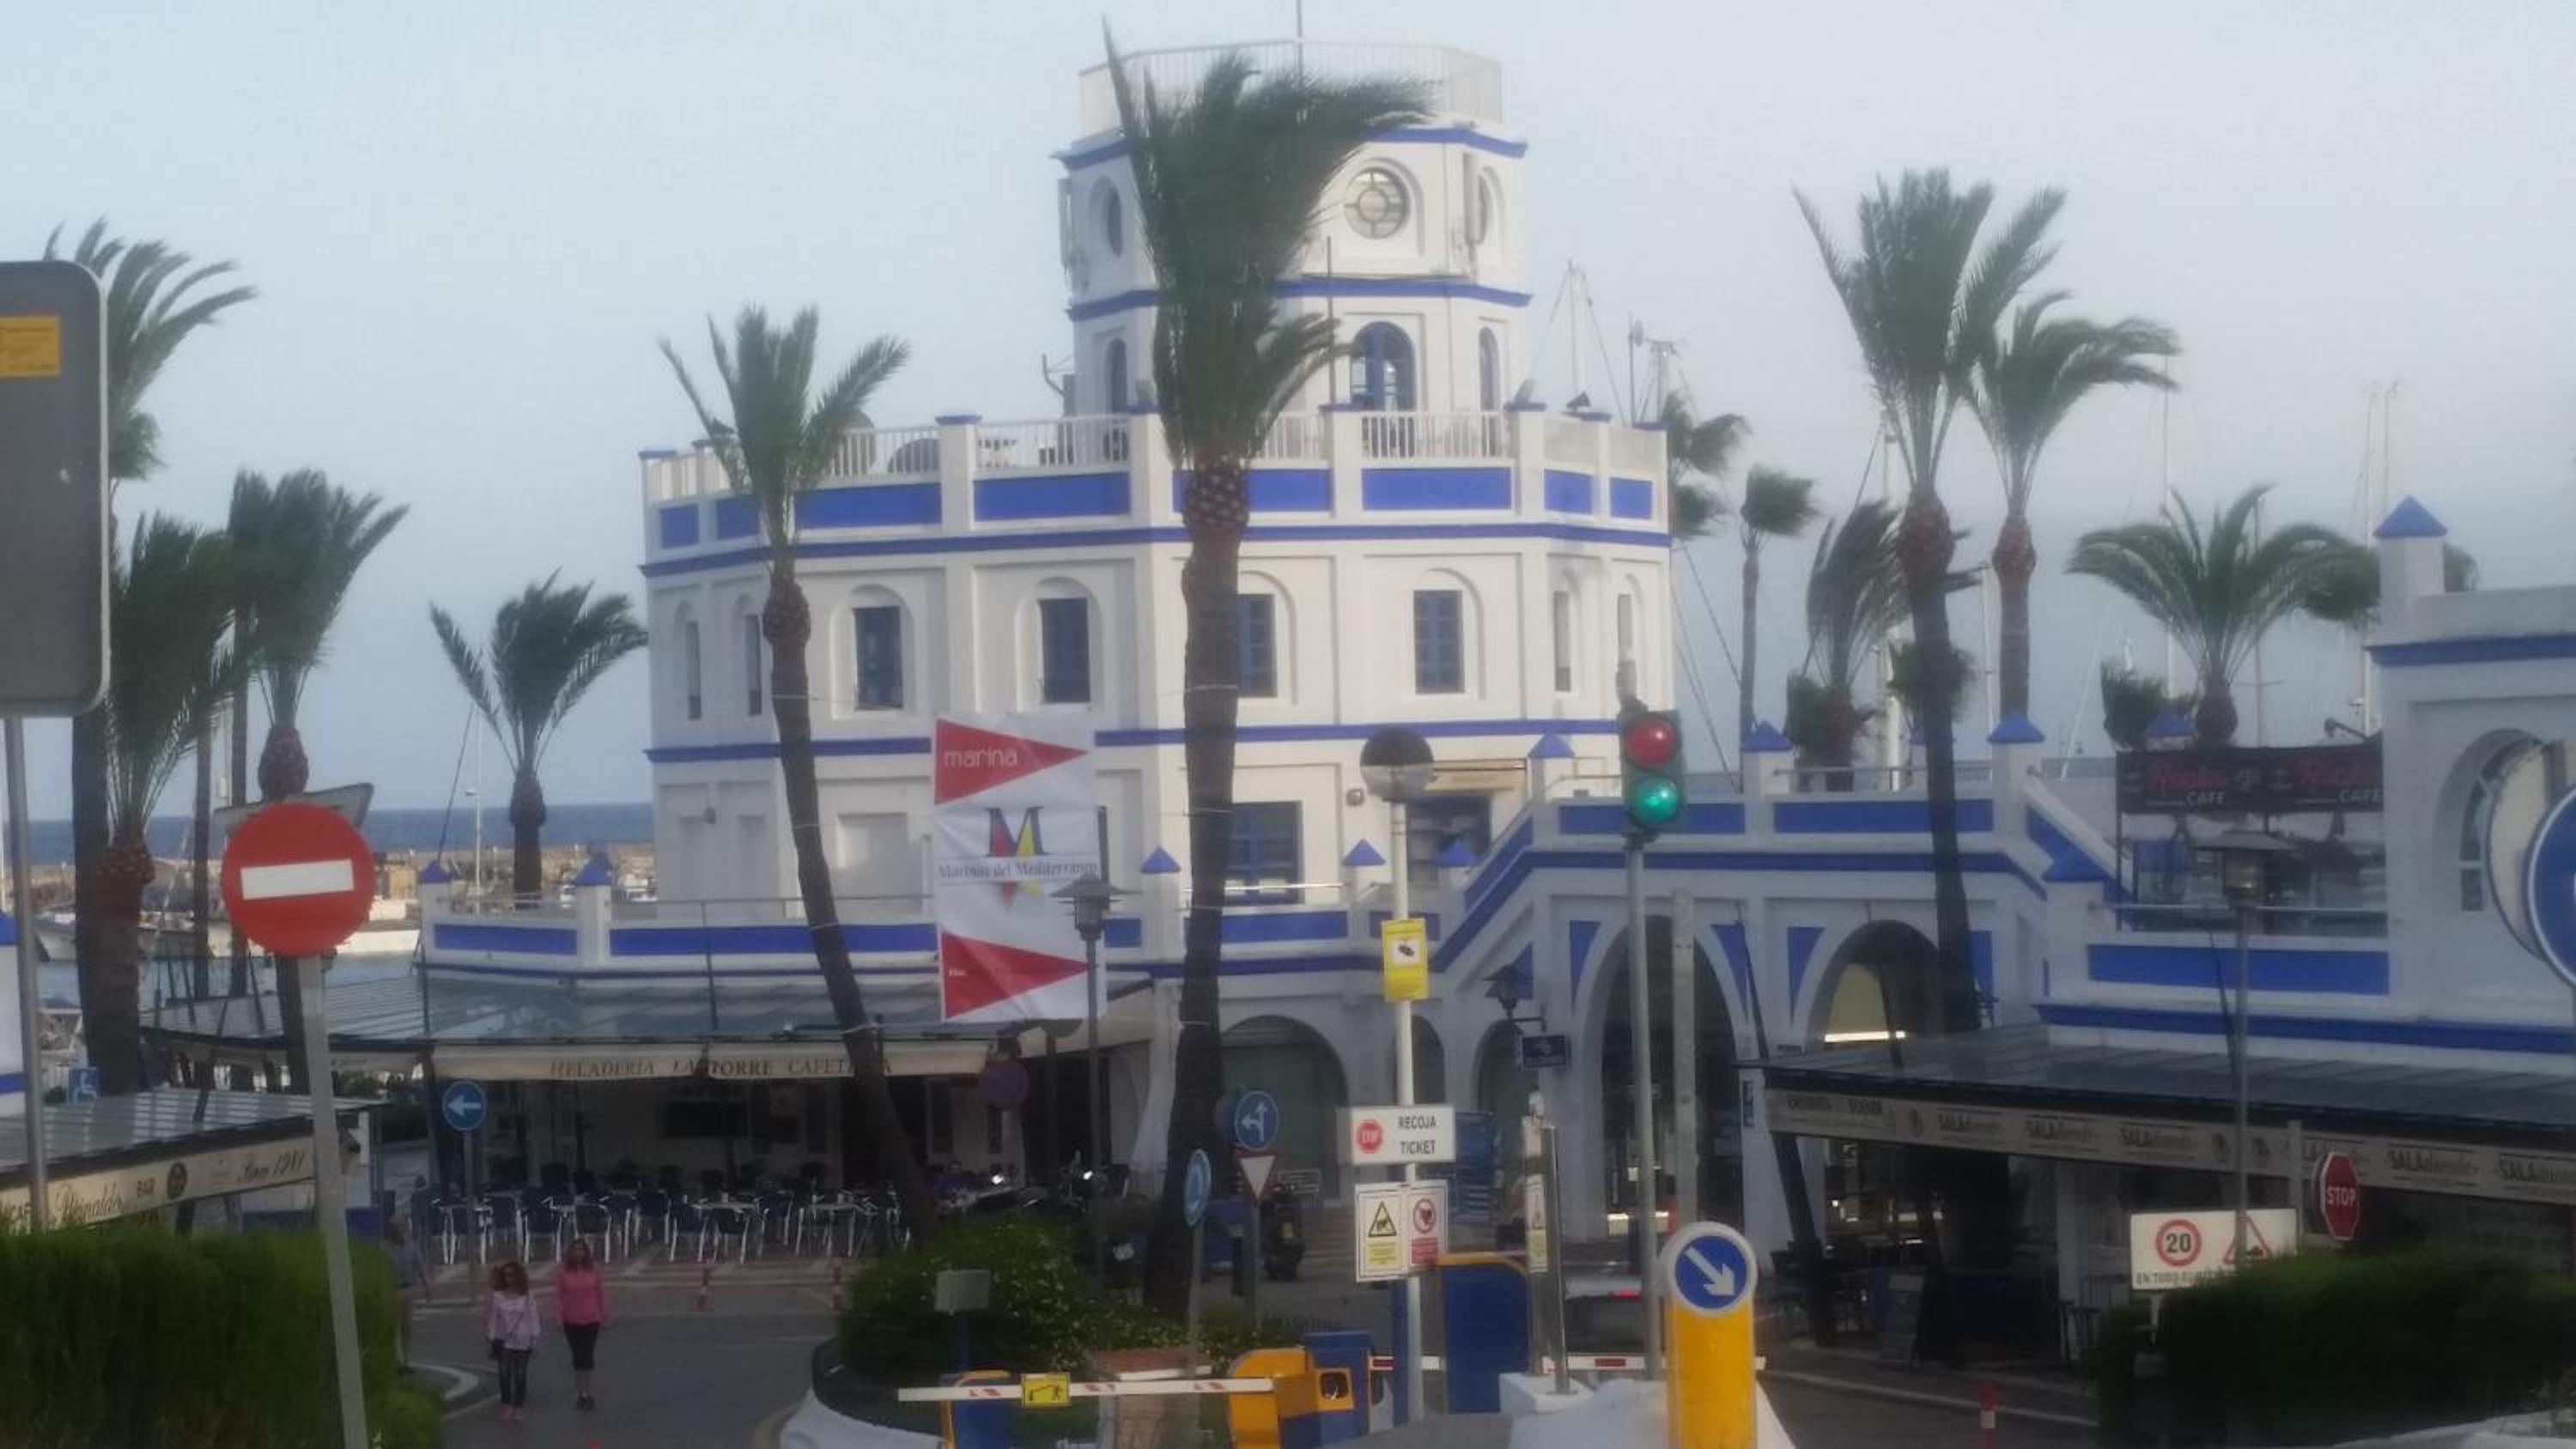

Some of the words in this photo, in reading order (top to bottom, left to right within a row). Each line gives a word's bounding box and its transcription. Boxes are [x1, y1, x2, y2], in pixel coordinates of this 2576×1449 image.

[945, 748, 1018, 767] marina
[1398, 1115, 1437, 1130] RECOJA
[1400, 1139, 1437, 1155] TICKET
[2326, 1186, 2357, 1206] STOP
[2166, 1233, 2192, 1254] 20
